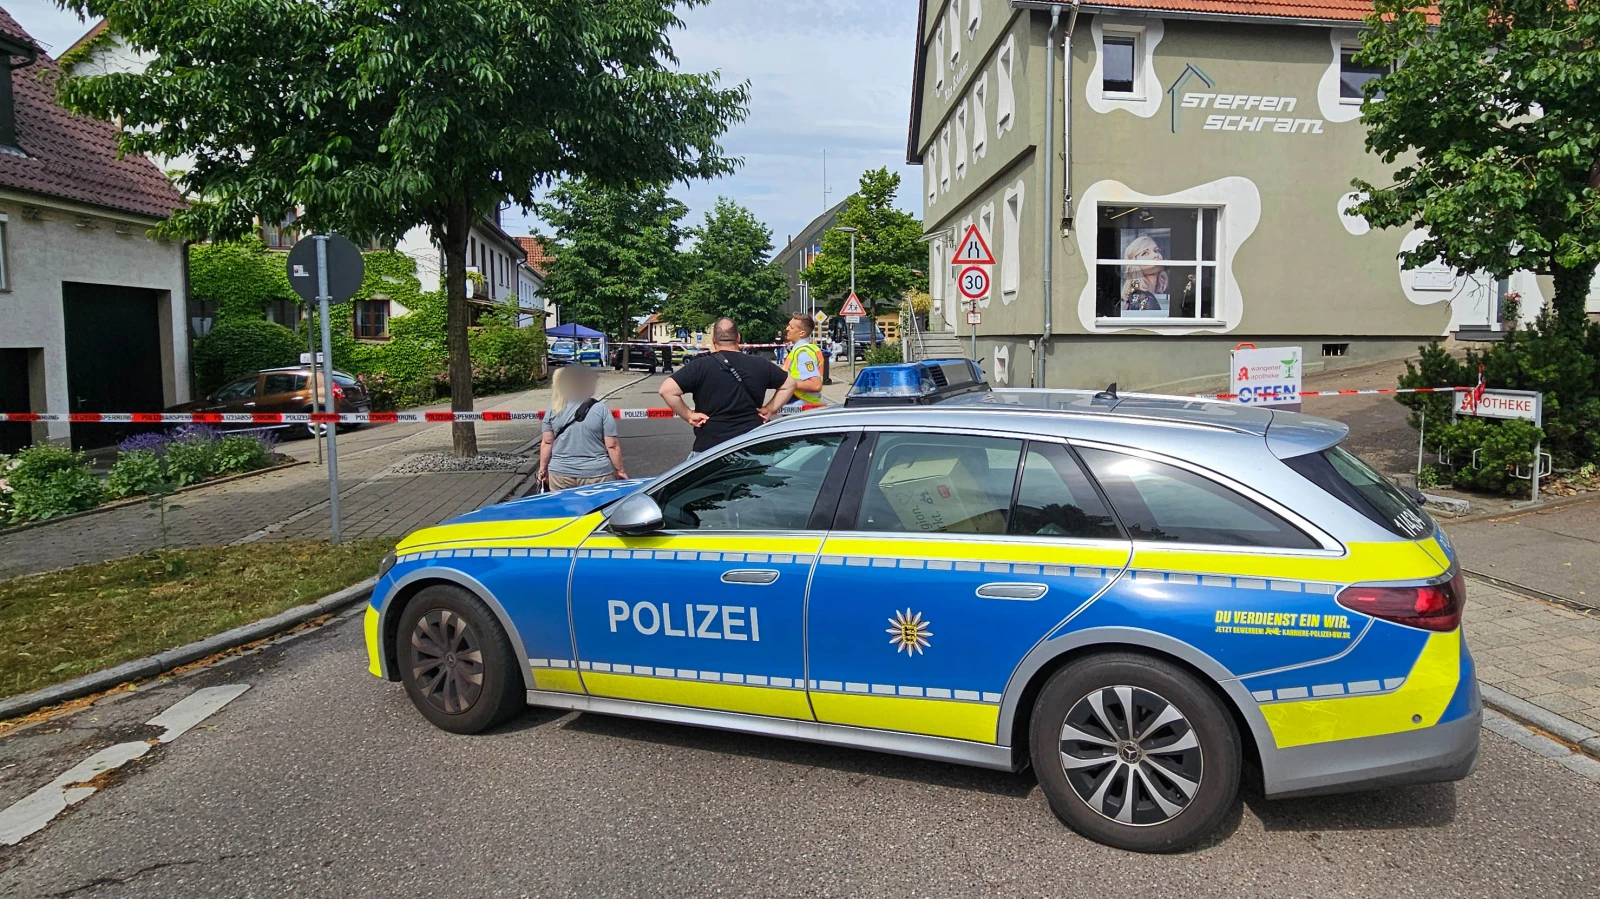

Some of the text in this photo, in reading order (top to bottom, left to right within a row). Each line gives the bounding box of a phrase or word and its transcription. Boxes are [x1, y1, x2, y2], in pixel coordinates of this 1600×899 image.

[965, 275, 983, 290] 30
[1250, 365, 1281, 373] wangener
[1250, 373, 1280, 381] apotheke
[1239, 385, 1296, 404] OFFEN
[1394, 508, 1426, 537] 1/434
[608, 599, 760, 642] POLIZEI
[1215, 610, 1351, 629] DU VERDIENST EIN WIR.
[1215, 626, 1232, 634] JETZT
